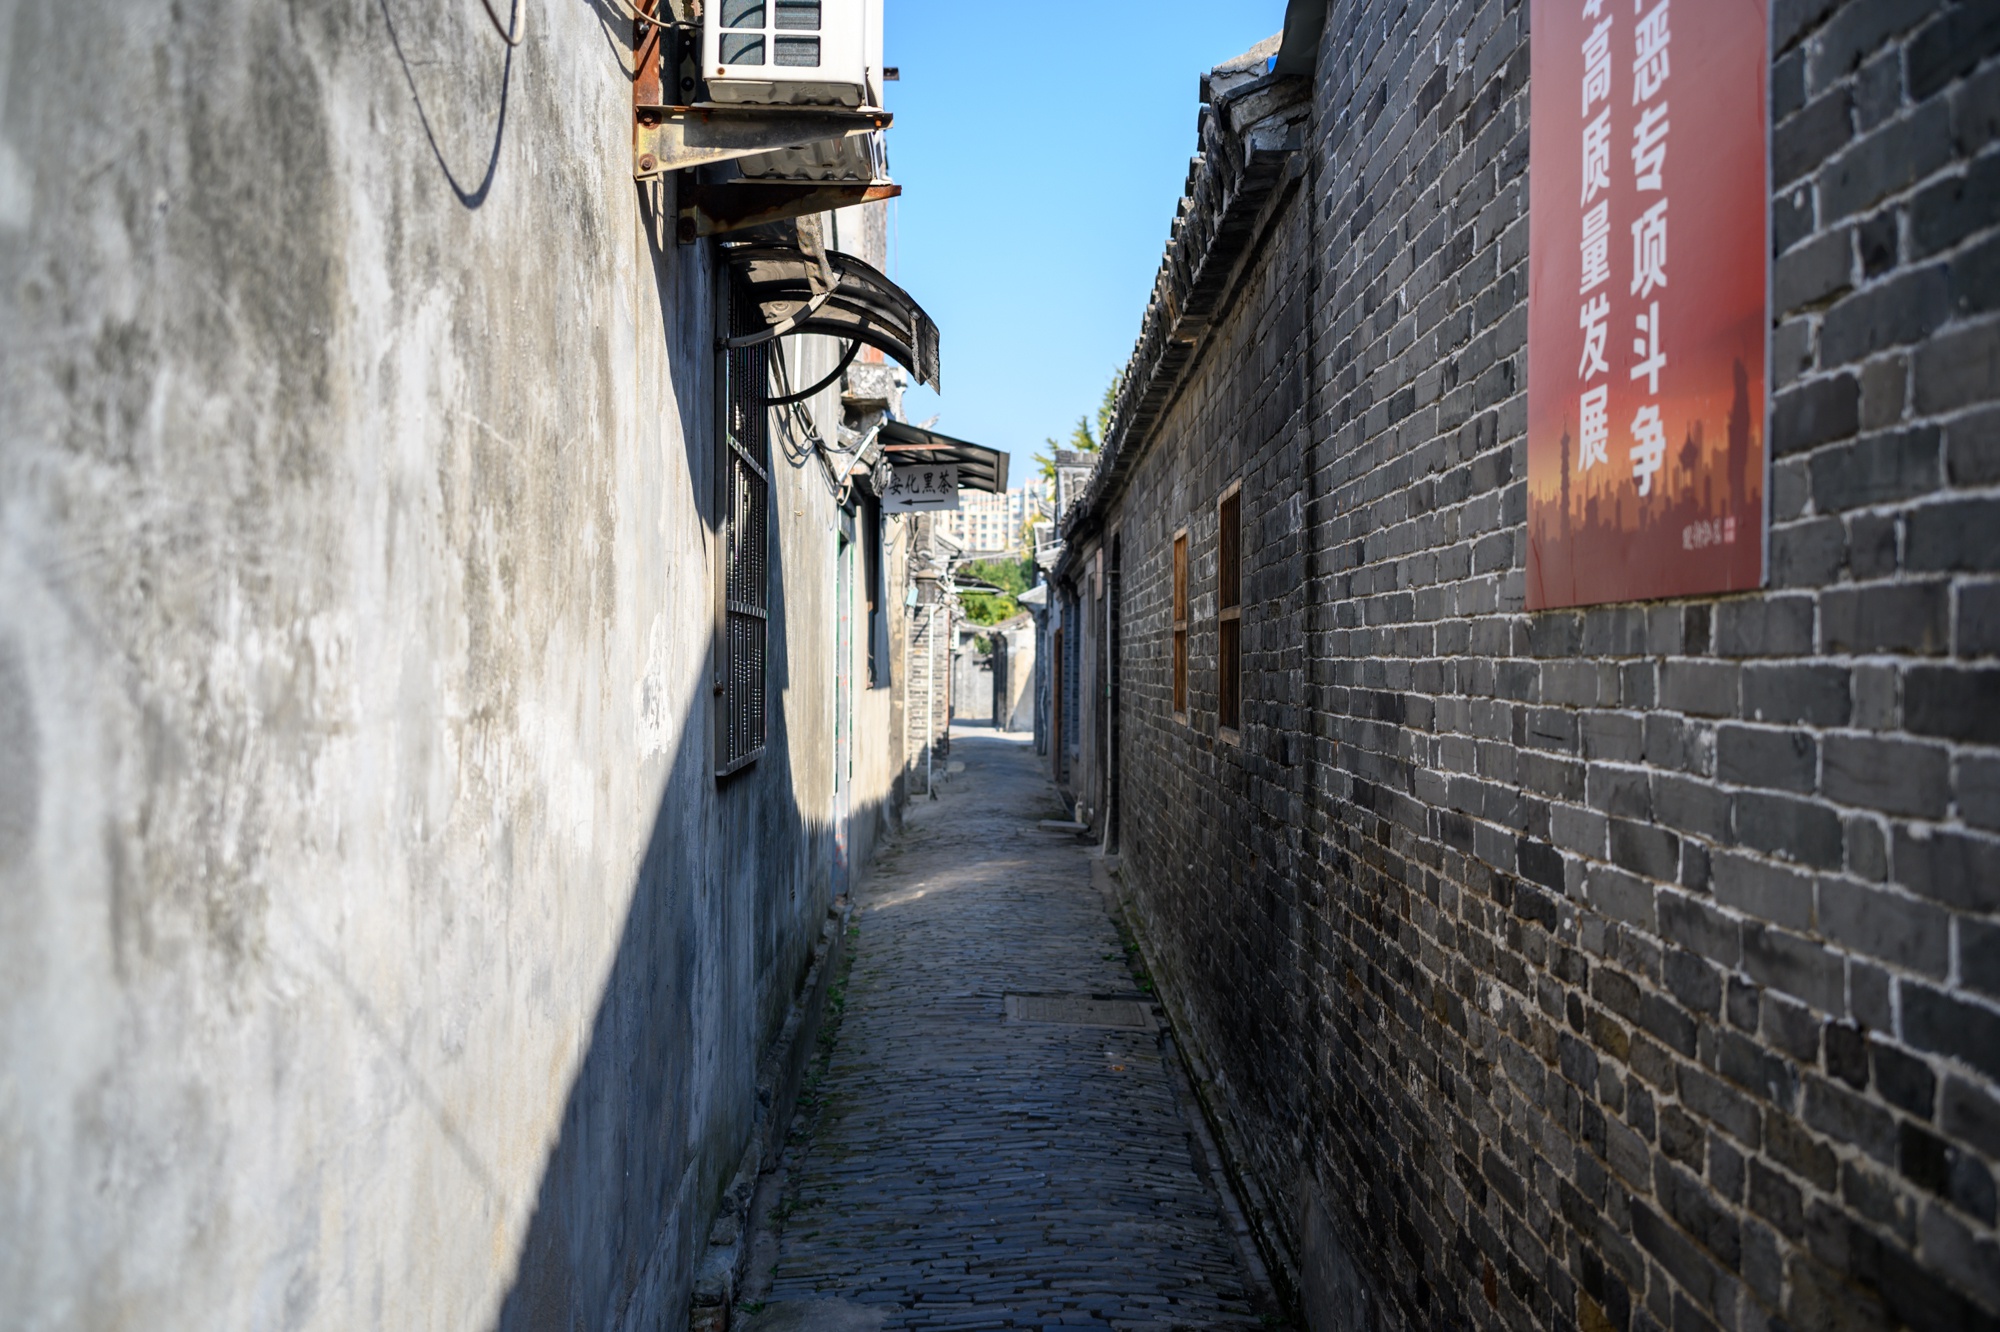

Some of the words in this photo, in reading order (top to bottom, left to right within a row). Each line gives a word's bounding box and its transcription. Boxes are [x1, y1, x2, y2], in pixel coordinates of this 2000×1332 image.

[1630, 0, 1670, 497] 恶专项斗争
[888, 470, 953, 495] 安化黑茶
